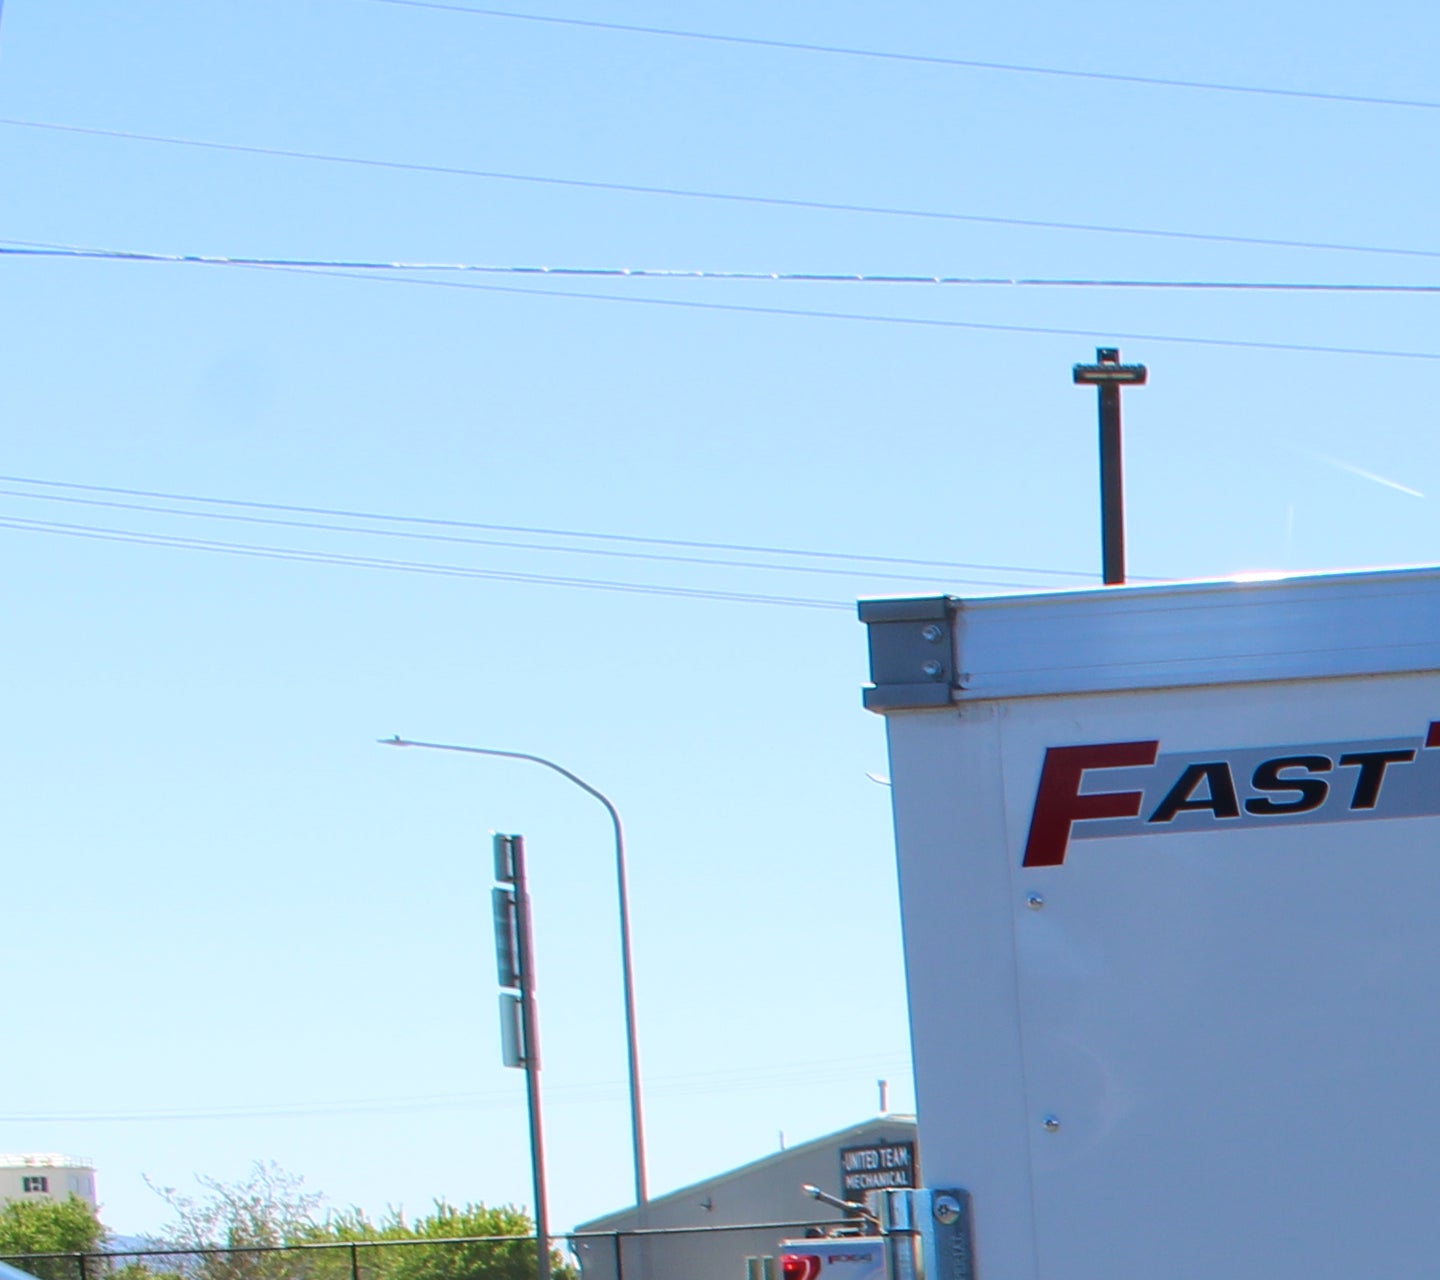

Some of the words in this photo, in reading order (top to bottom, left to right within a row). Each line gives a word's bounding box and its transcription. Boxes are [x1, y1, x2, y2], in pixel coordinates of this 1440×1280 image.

[843, 1149, 879, 1171] UNITED
[880, 1146, 908, 1167] TEAM
[845, 1171, 909, 1189] MECHANICAL
